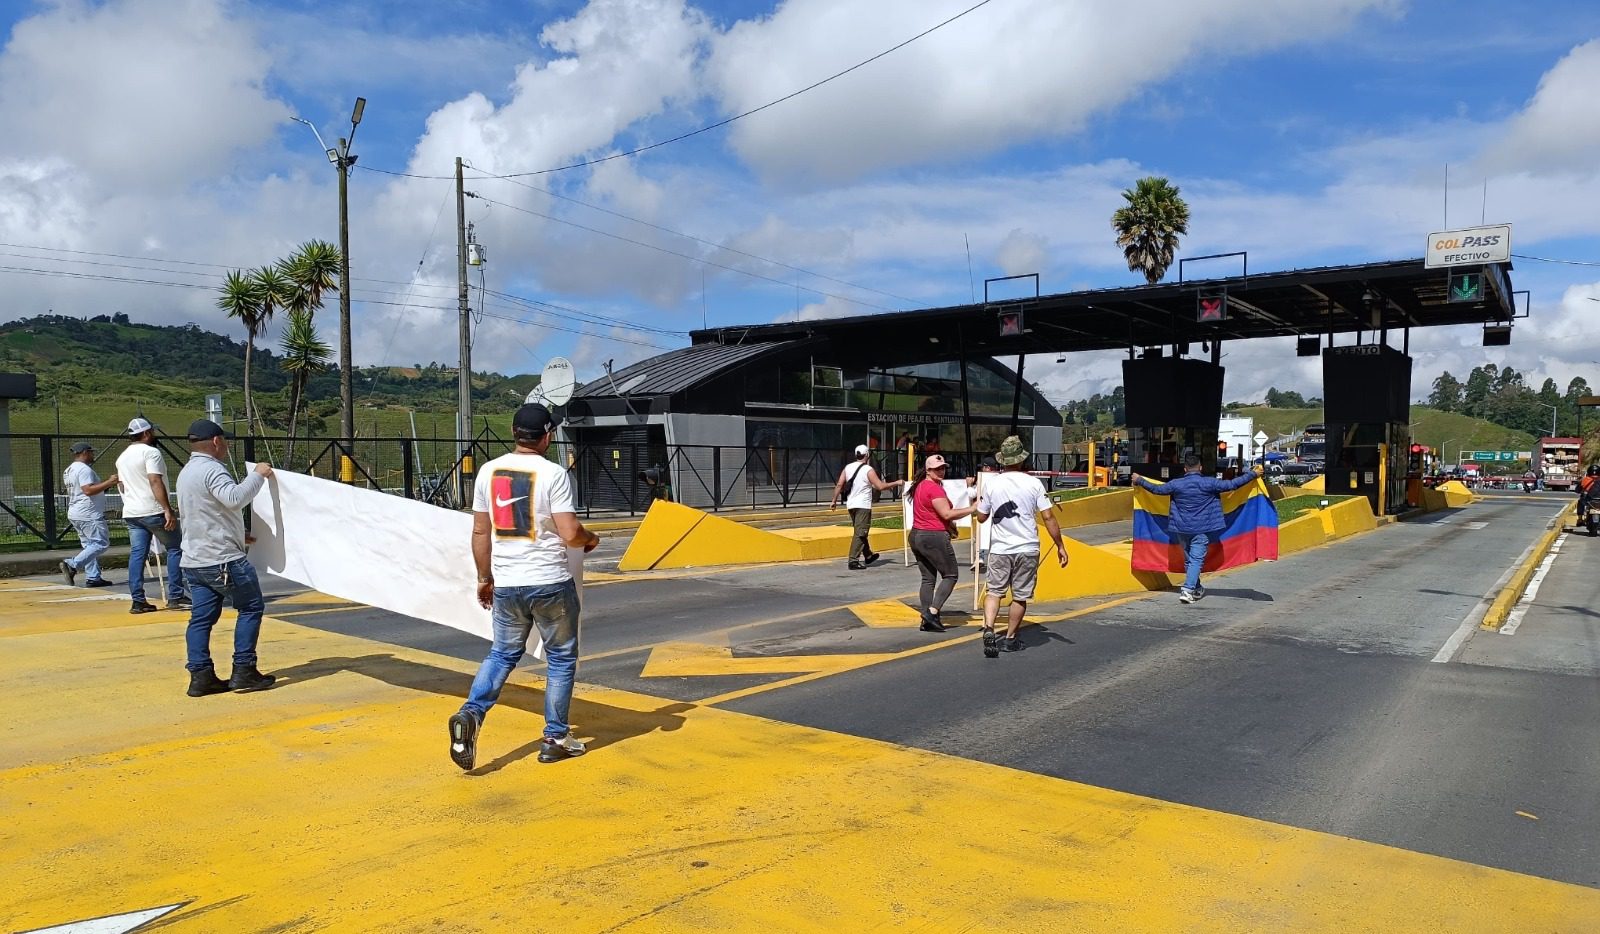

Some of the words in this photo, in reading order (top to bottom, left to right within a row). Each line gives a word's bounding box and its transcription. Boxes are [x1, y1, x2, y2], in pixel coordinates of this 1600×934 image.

[1435, 235, 1500, 250] COLPASS
[1444, 251, 1490, 262] EFECTIVO
[898, 414, 907, 423] DE
[907, 414, 925, 424] PEAJE
[925, 415, 933, 424] EL
[933, 415, 964, 424] SANTUARIO
